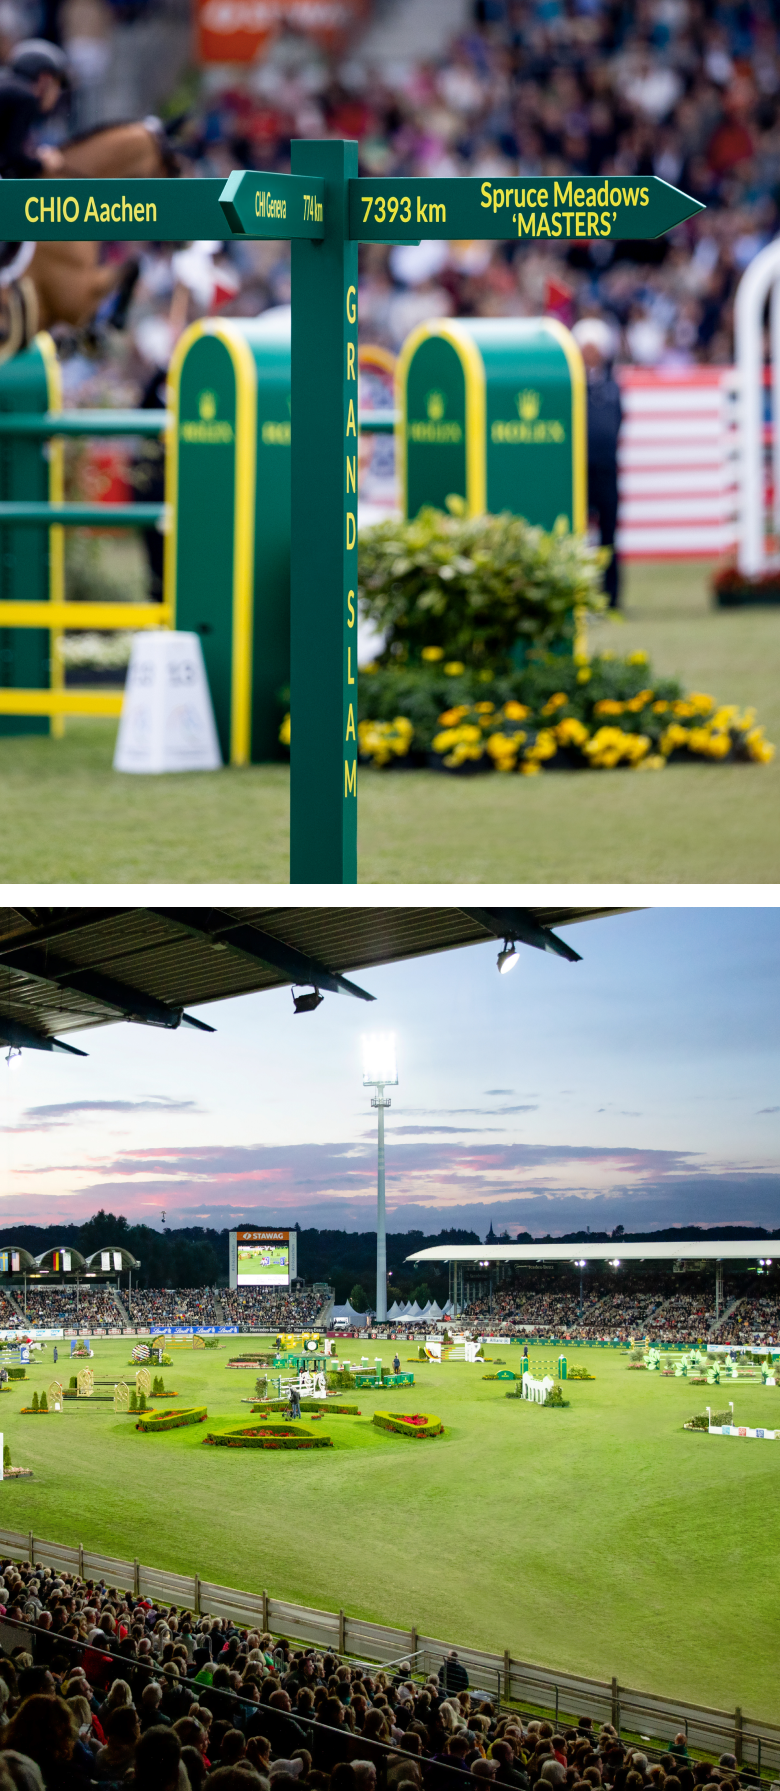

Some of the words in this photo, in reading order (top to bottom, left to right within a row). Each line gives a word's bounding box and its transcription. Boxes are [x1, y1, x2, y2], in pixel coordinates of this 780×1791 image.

[24, 196, 80, 223] CHIO
[83, 195, 157, 223] Aachen
[255, 190, 266, 218] CHI
[266, 191, 287, 219] Geneva
[303, 194, 314, 221] 774
[314, 195, 324, 222] km
[360, 196, 412, 223] 7393
[416, 196, 446, 223] km
[480, 181, 549, 214] Spruce
[553, 180, 649, 208] Meadows
[346, 285, 357, 551] GRAND
[490, 420, 566, 444] ROLEX
[344, 589, 357, 798] SLAM
